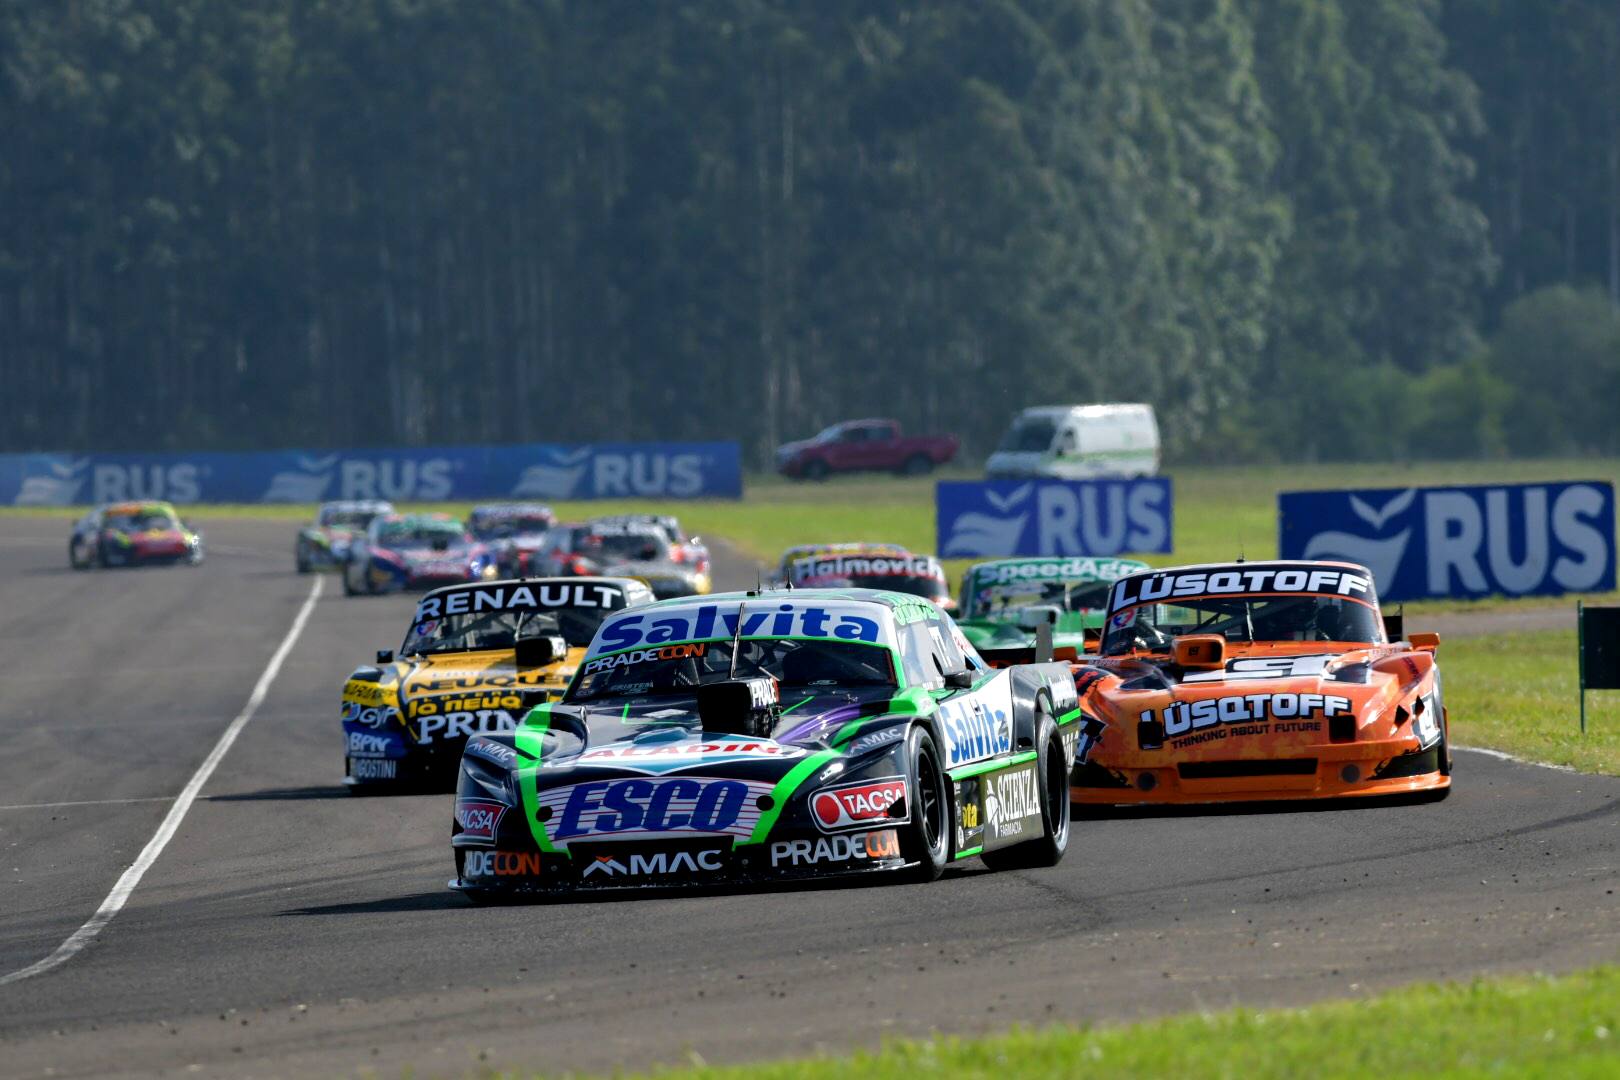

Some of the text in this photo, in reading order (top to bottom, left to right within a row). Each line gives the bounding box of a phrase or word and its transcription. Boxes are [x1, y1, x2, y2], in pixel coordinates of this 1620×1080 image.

[93, 463, 199, 503] RUS
[342, 458, 452, 499] RUS
[594, 453, 703, 497] RUS
[1038, 483, 1167, 556] RUS
[1424, 484, 1607, 594] RUS
[793, 554, 942, 582] Haimovich
[978, 559, 1142, 584] SpeedAgr
[415, 585, 622, 621] RENAULT
[1112, 569, 1370, 612] LÜSQTOFF
[599, 602, 880, 654] Salvita
[584, 642, 706, 675] PRADECON
[864, 728, 902, 746] MAC
[940, 694, 1010, 764] Salvita
[1171, 722, 1321, 749] THINKING ABOUT FUTURE
[553, 779, 749, 840] ESCO
[998, 768, 1041, 824] SCIENZA
[1000, 821, 1022, 837] FARMACIA
[629, 850, 723, 876] MAC
